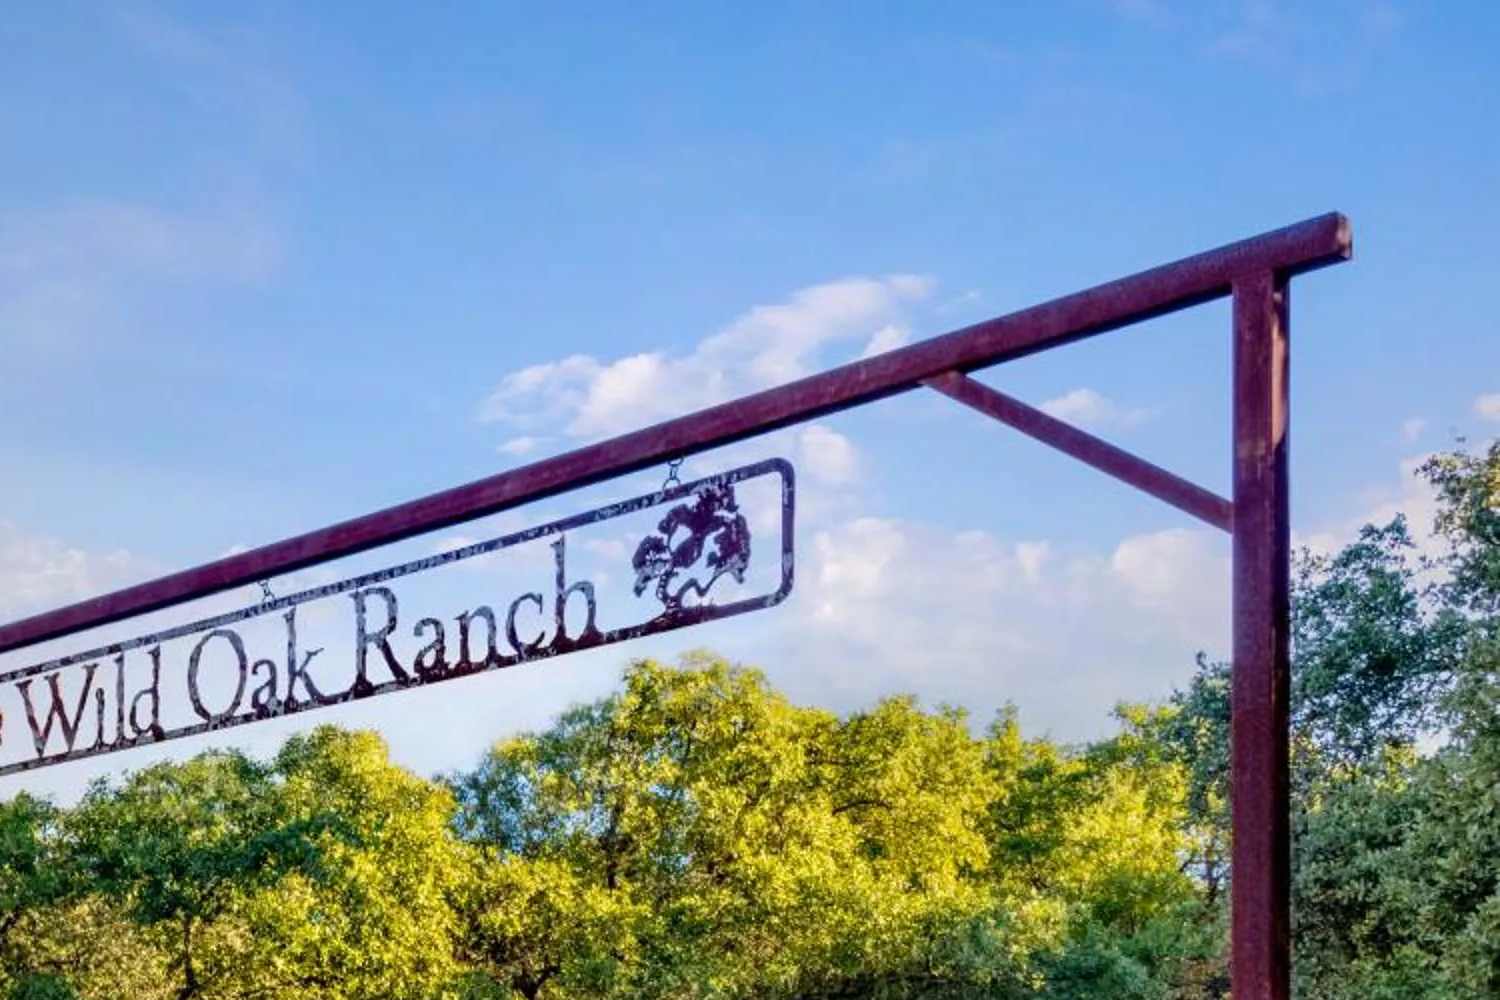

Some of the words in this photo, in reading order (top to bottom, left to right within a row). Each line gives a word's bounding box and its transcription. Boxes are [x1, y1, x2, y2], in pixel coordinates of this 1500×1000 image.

[16, 645, 164, 758] Wild
[188, 607, 329, 724] Oak
[348, 534, 603, 697] Ranch
